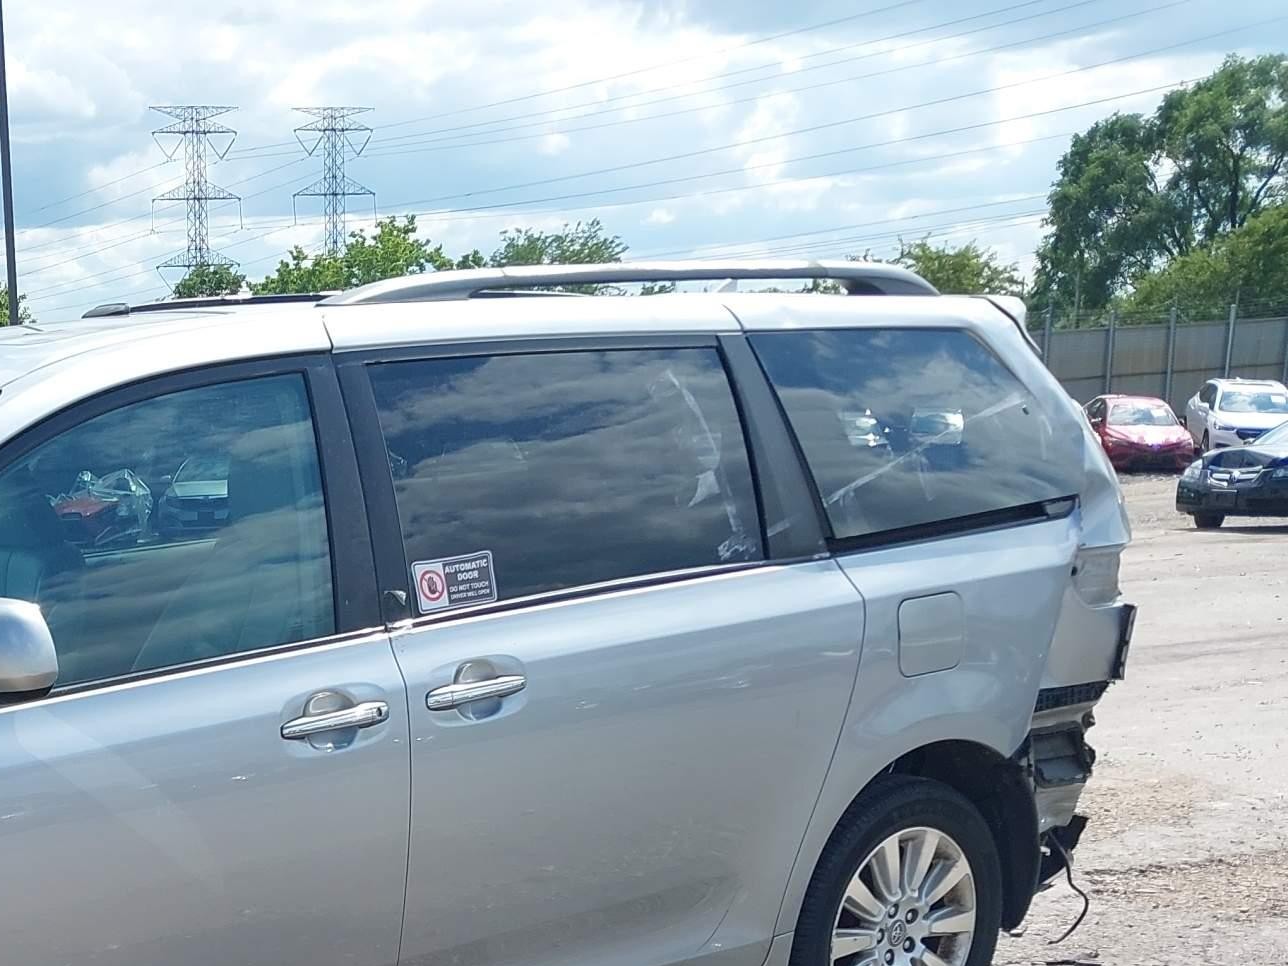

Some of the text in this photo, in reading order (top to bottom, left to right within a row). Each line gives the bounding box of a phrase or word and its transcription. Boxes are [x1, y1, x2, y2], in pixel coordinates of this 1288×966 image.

[444, 559, 488, 575] AUTOMATIC
[457, 570, 479, 581] DOOR
[449, 580, 489, 593] DO NOT TOUCH
[450, 591, 467, 600] DRIVER
[477, 588, 490, 596] OPEN
